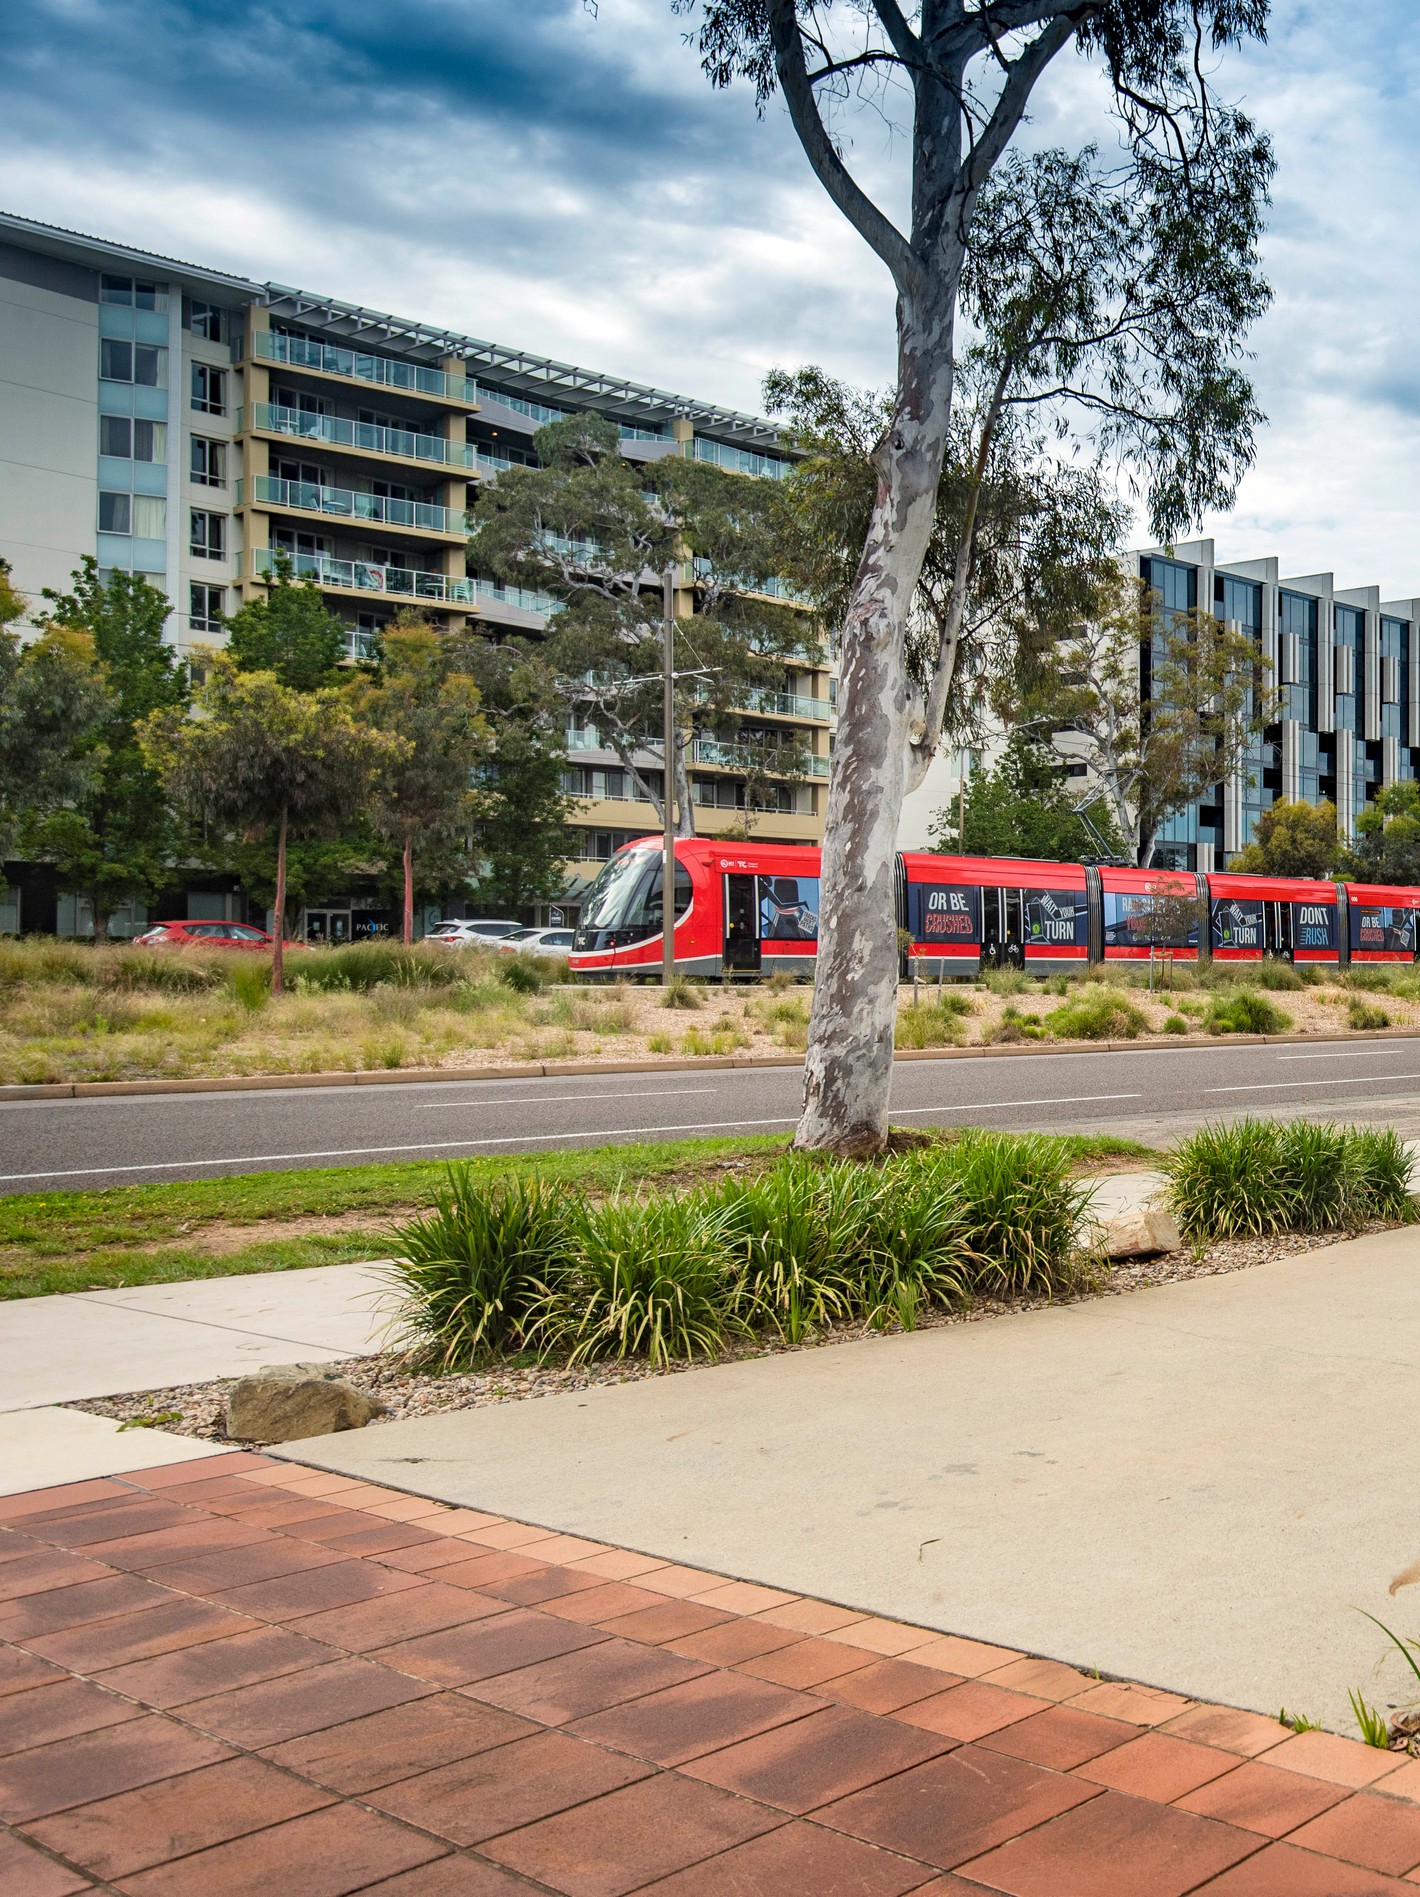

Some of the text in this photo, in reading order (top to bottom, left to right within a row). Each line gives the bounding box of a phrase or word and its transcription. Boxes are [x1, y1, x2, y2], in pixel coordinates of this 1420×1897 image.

[928, 891, 970, 911] OR BE
[1040, 894, 1058, 915] WAIT
[1058, 906, 1075, 918] YOUR
[1229, 904, 1244, 923] WAIT
[1245, 914, 1258, 925] YOUR
[1299, 906, 1329, 925] DONT
[356, 921, 389, 932] PACIFIC
[924, 912, 974, 934] CRUSHED
[1044, 920, 1074, 940] TURN
[1361, 916, 1381, 928] OR BE
[1233, 927, 1256, 944] TURN
[1305, 927, 1329, 945] RUSH
